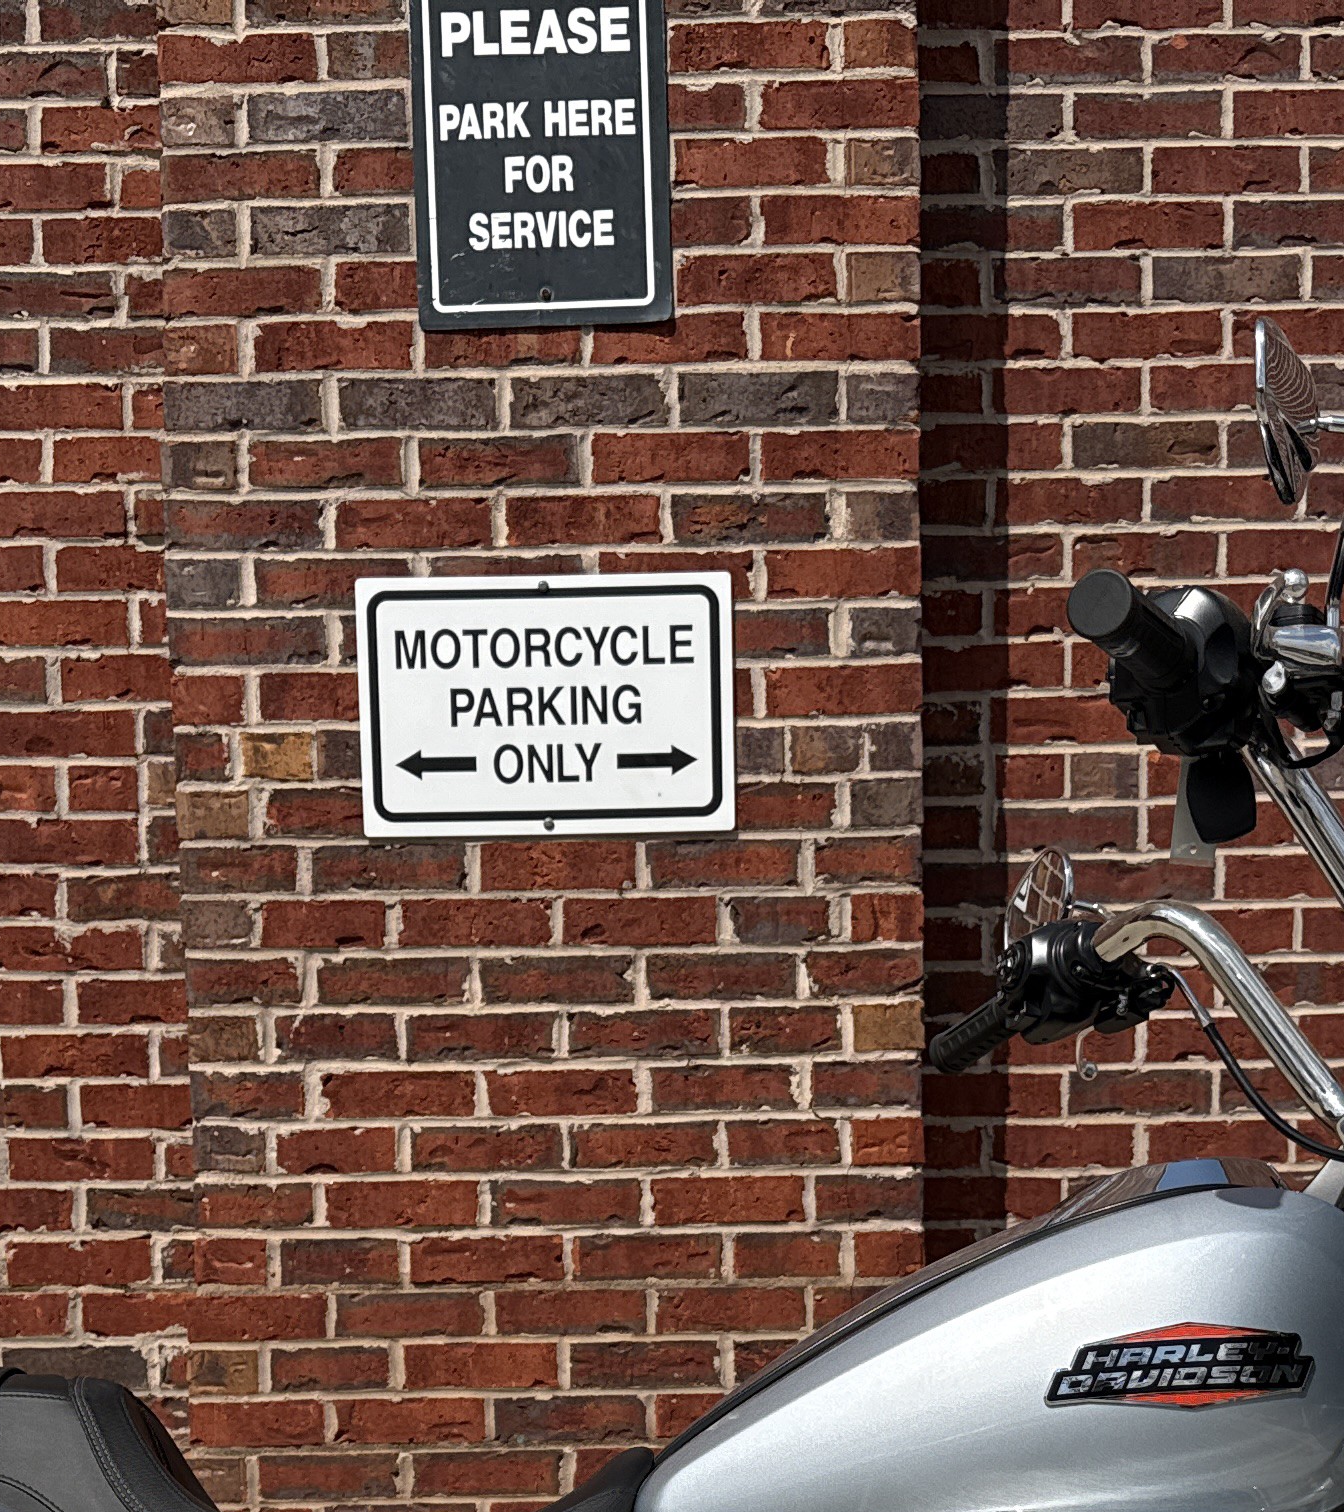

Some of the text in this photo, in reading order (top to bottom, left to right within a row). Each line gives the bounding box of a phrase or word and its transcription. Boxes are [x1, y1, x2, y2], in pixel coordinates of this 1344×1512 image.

[440, 6, 631, 57] PLEASE
[439, 98, 636, 141] PARK HERE
[504, 155, 574, 194] FOR
[468, 209, 615, 251] SERVICE
[394, 624, 695, 670] MOTORCYCLE
[450, 684, 642, 727] PARKING
[493, 742, 602, 784] ONLY
[1057, 1365, 1303, 1395] DAVIDSON
